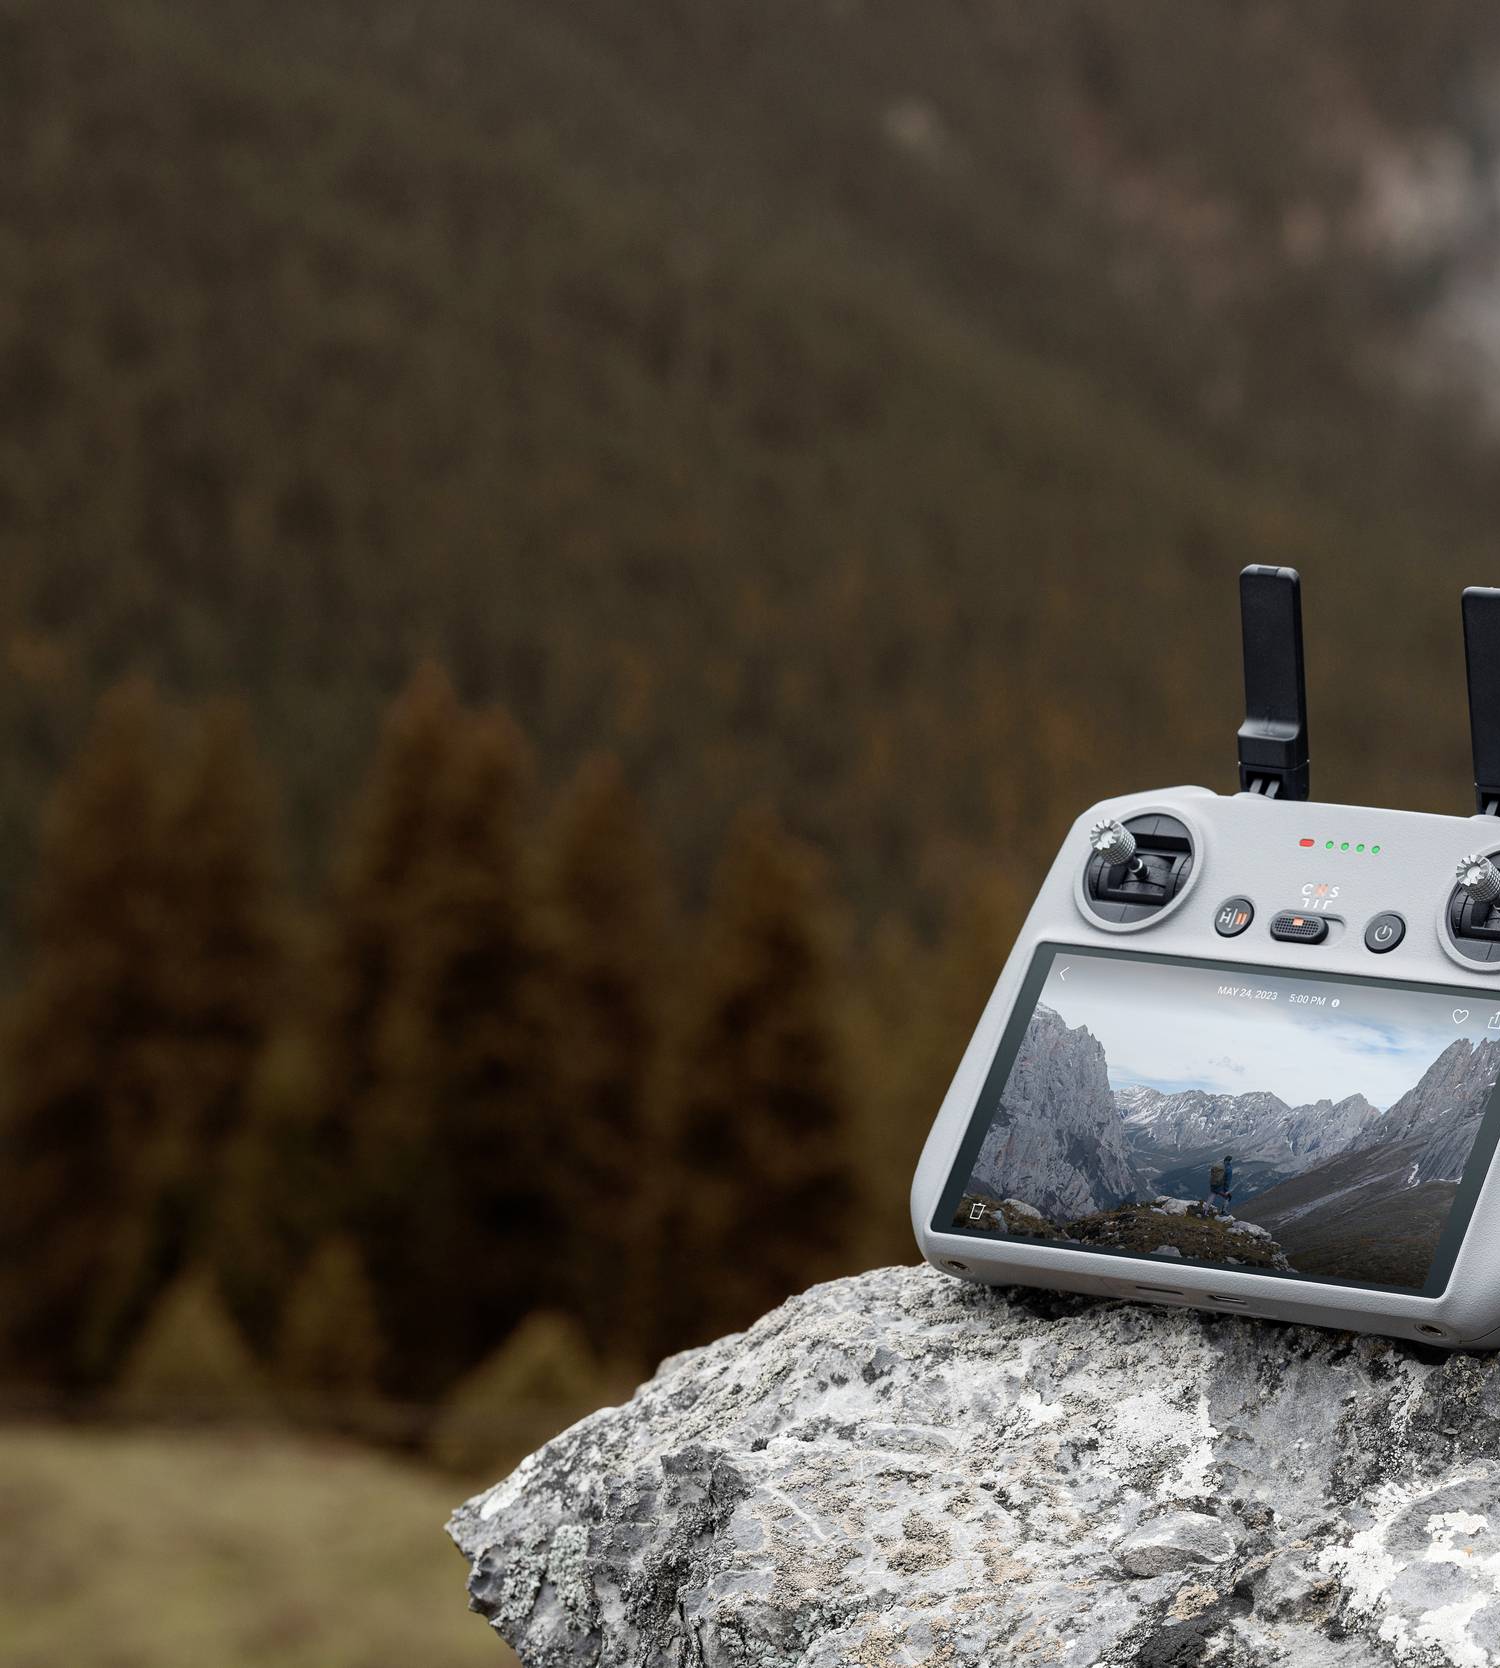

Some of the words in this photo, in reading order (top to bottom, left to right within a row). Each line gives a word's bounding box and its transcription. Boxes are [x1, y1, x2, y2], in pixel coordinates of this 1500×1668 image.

[1217, 985, 1240, 997] MAY
[1255, 990, 1278, 1001] 2023
[1289, 993, 1309, 1004] 5:00
[1310, 996, 1326, 1006] PM
